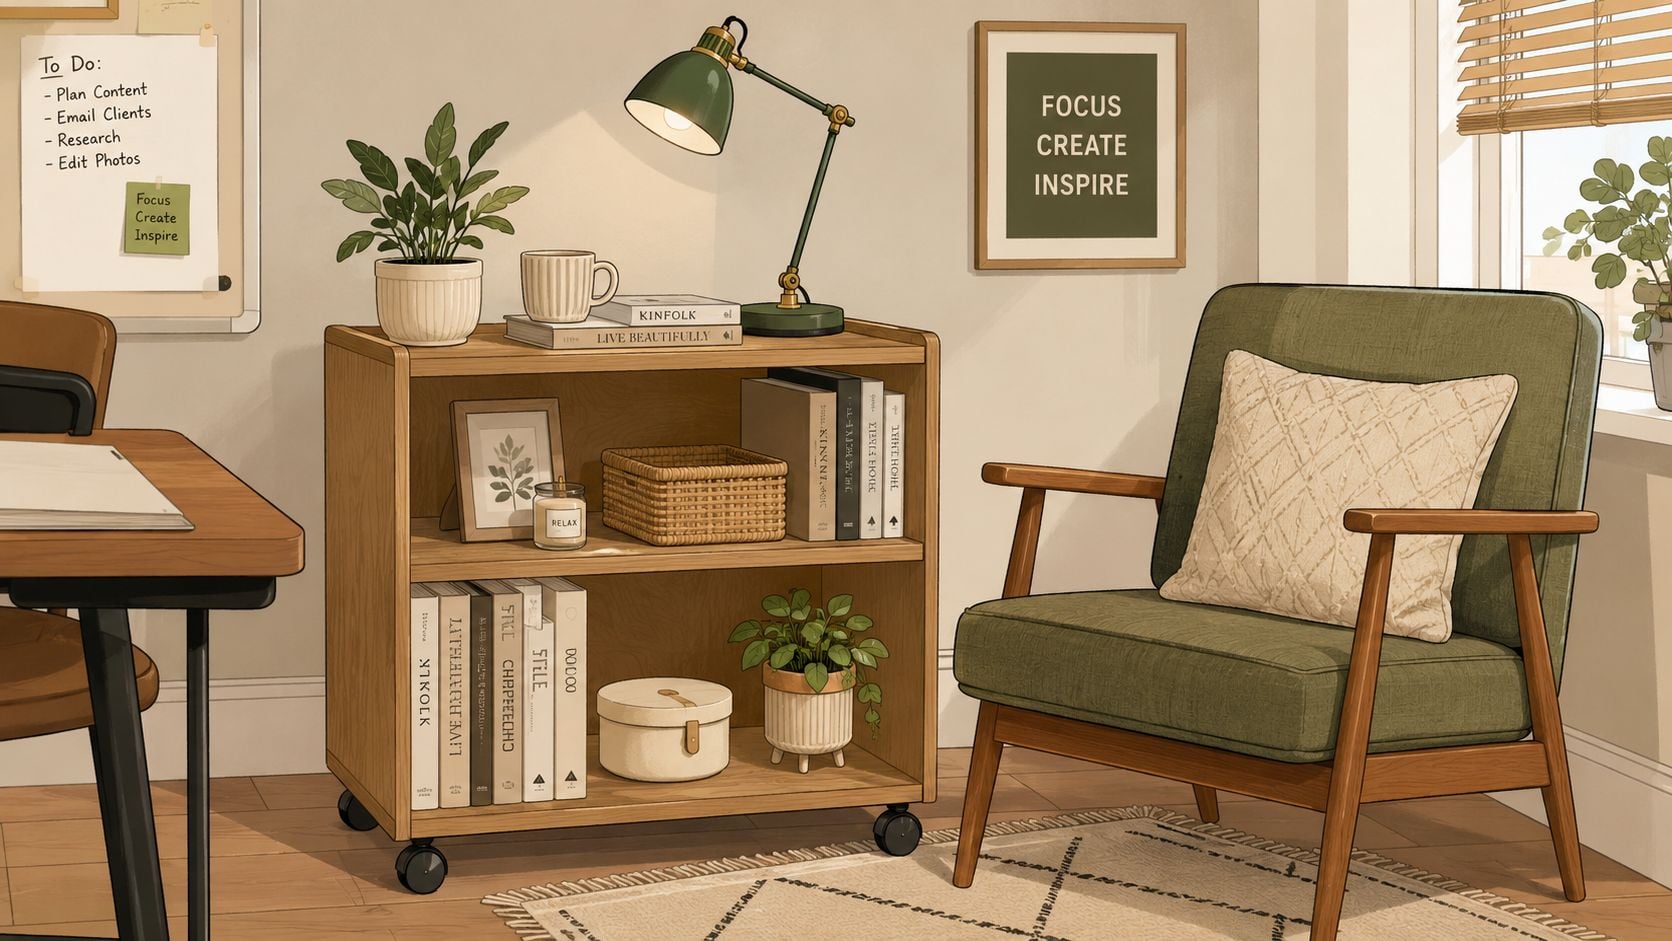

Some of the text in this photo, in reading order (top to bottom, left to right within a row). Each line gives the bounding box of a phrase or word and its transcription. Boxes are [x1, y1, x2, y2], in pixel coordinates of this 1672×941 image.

[37, 55, 101, 74] To Do:
[56, 86, 87, 102] Plan
[93, 81, 148, 99] Content
[57, 107, 96, 125] Email
[103, 104, 152, 121] Clients
[1042, 94, 1122, 117] FOCUS
[57, 129, 121, 148] Research
[1036, 133, 1127, 156] CREATE
[58, 154, 88, 171] Edit
[95, 151, 141, 168] Photos
[1035, 173, 1129, 196] INSPIRE
[136, 192, 171, 206] Focus
[135, 210, 177, 224] Create
[134, 228, 179, 245] Inspire
[639, 310, 696, 321] KINFOLK
[597, 332, 626, 344] LIVE
[629, 330, 711, 343] BEAUTIFULLY
[551, 519, 578, 527] RELAX
